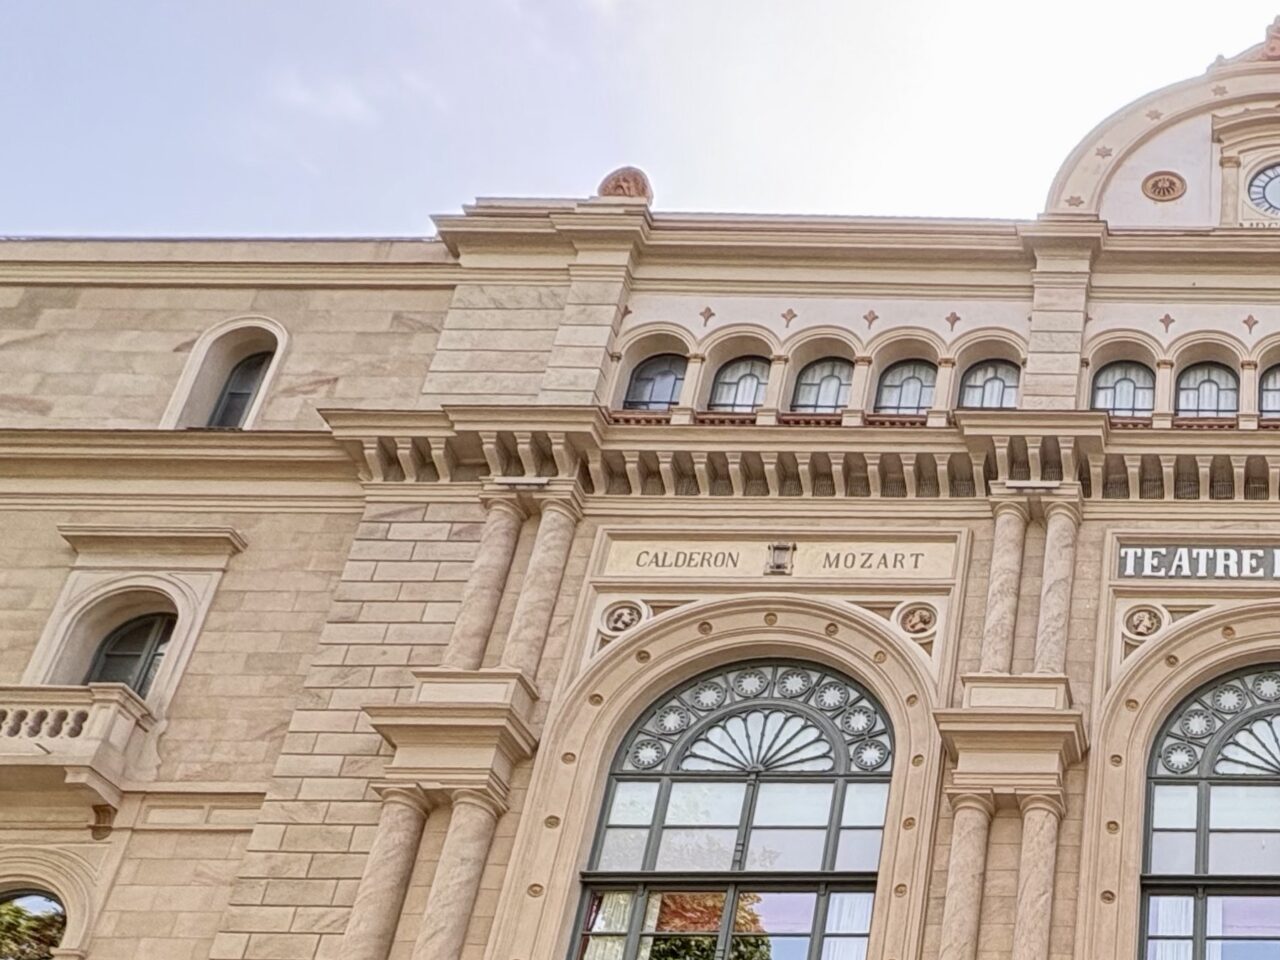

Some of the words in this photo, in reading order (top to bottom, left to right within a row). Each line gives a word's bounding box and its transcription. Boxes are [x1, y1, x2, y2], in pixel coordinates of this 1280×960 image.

[635, 551, 740, 568] CALDERON
[822, 552, 925, 569] MOZART
[1120, 547, 1264, 577] TEATRE
